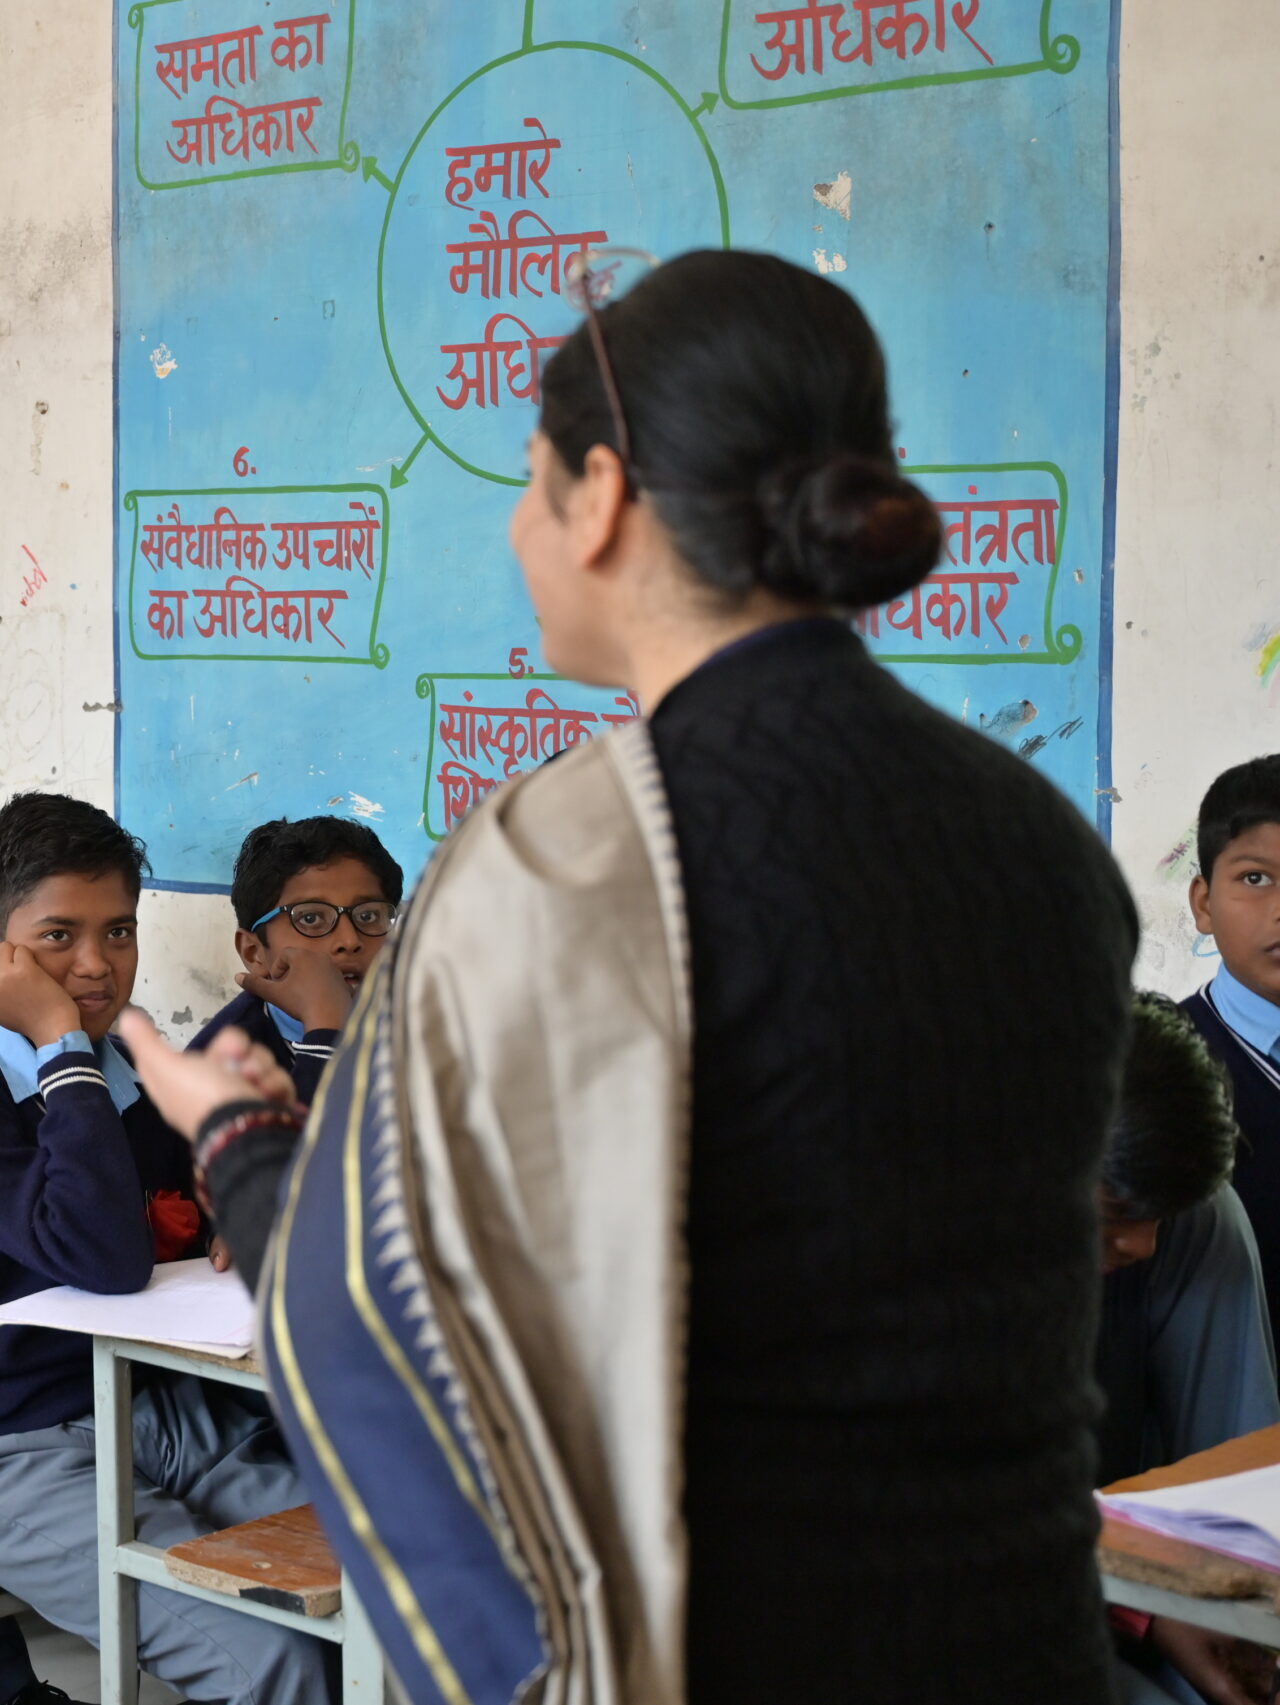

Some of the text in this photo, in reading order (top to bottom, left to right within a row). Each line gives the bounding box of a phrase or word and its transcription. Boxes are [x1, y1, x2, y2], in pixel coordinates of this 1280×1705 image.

[154, 13, 332, 100] समता का
[166, 95, 323, 166] अधिकार
[444, 117, 562, 211] हमारे
[232, 446, 257, 477] 6.
[140, 503, 267, 573] संवैधानिक
[147, 575, 350, 649] का अधिकार
[508, 647, 535, 680] 5.
